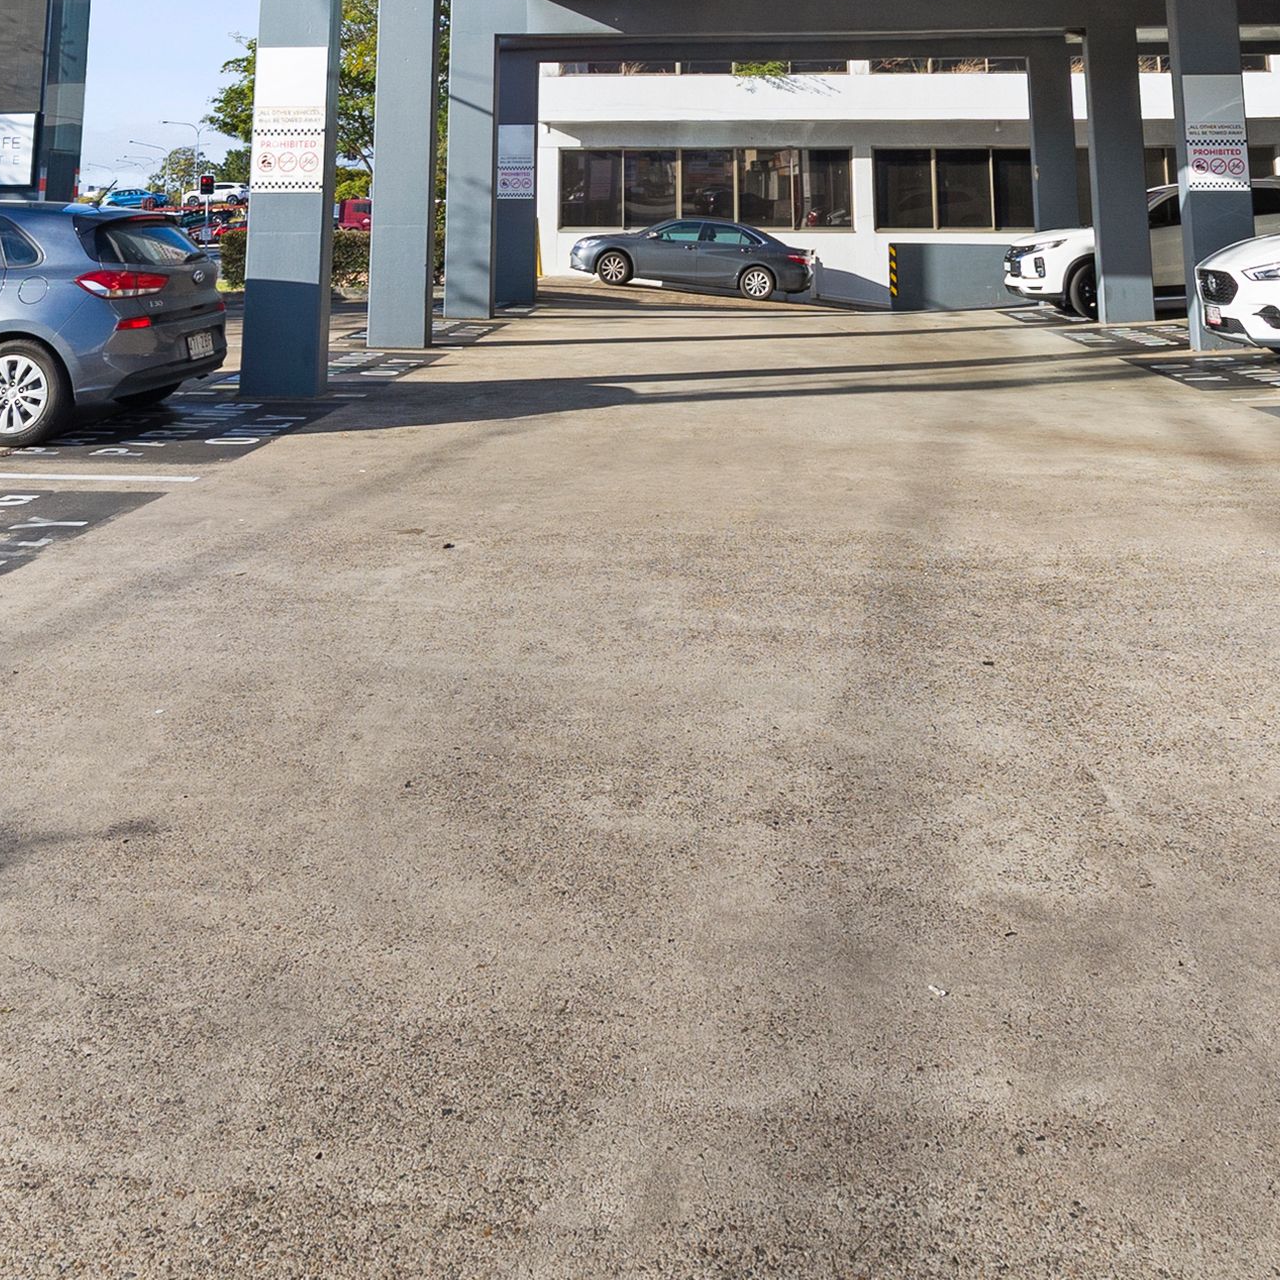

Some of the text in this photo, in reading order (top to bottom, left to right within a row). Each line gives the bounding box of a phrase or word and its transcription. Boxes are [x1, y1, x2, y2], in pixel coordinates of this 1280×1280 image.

[260, 140, 317, 148] PROHIBITED
[88, 403, 264, 457] PARKING
[204, 414, 308, 445] ONLY
